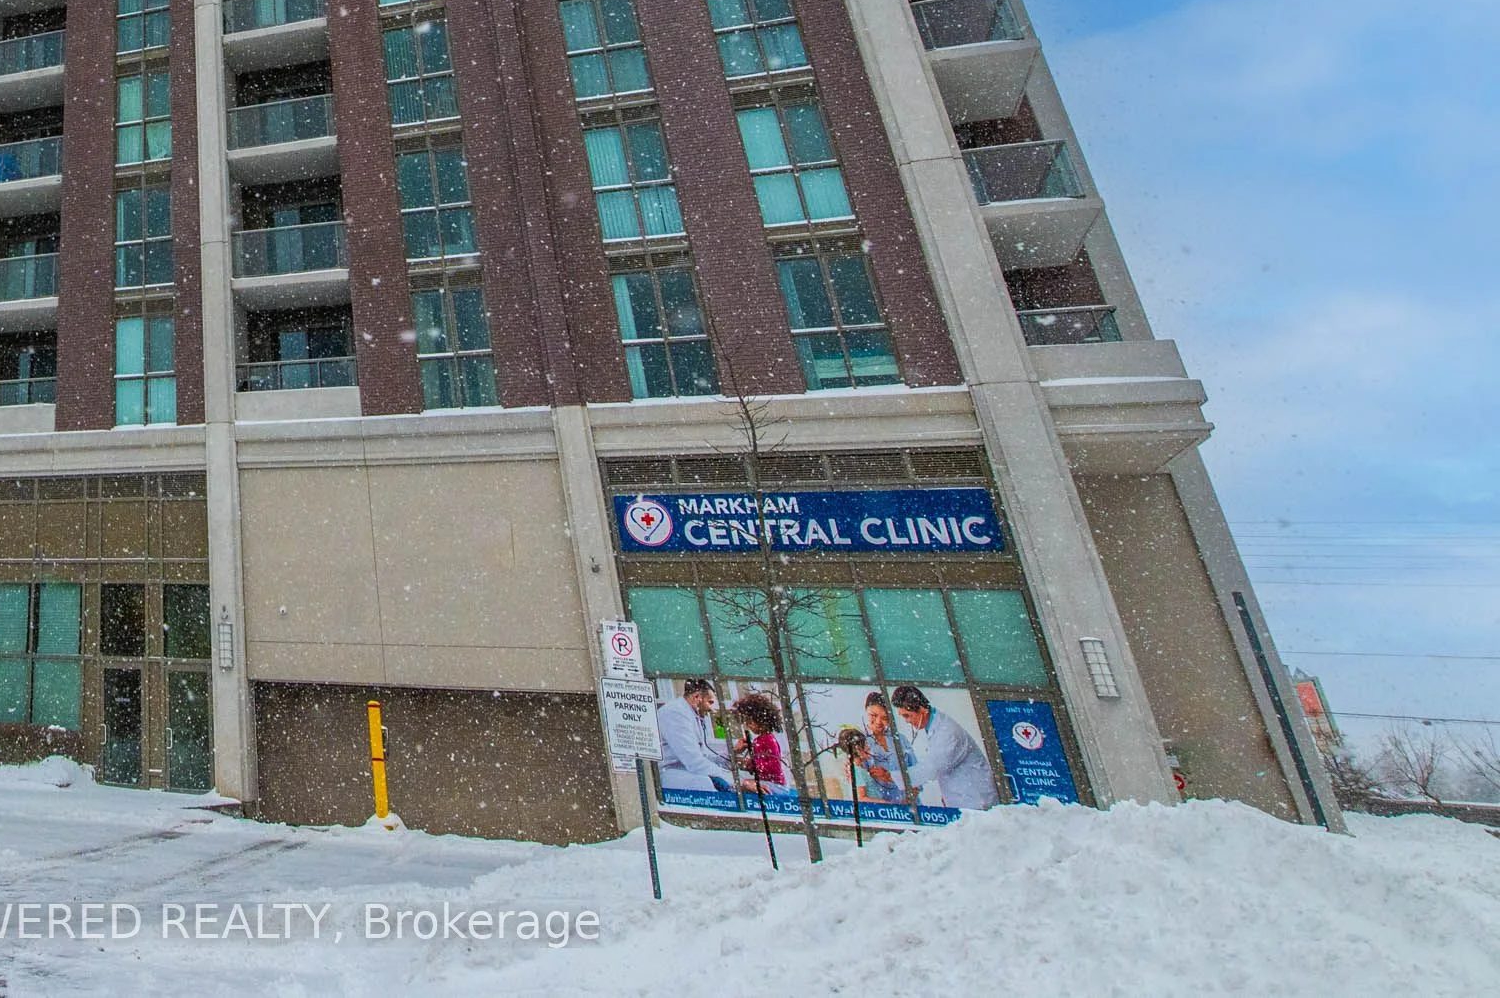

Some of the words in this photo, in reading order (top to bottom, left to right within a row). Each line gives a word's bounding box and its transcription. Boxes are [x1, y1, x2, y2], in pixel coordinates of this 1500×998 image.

[678, 496, 800, 515] MARKHAM
[684, 518, 852, 547] CENTRAL
[860, 516, 991, 545] CLINIC
[606, 691, 653, 703] AUTHORIZED
[614, 702, 647, 713] PARKING
[622, 713, 642, 722] ONLY
[1018, 760, 1053, 768] MARKHAM
[1016, 768, 1061, 778] CENTRAL
[1025, 777, 1057, 787] CLINIC
[878, 808, 912, 821] Clinic
[921, 811, 949, 823] (905)
